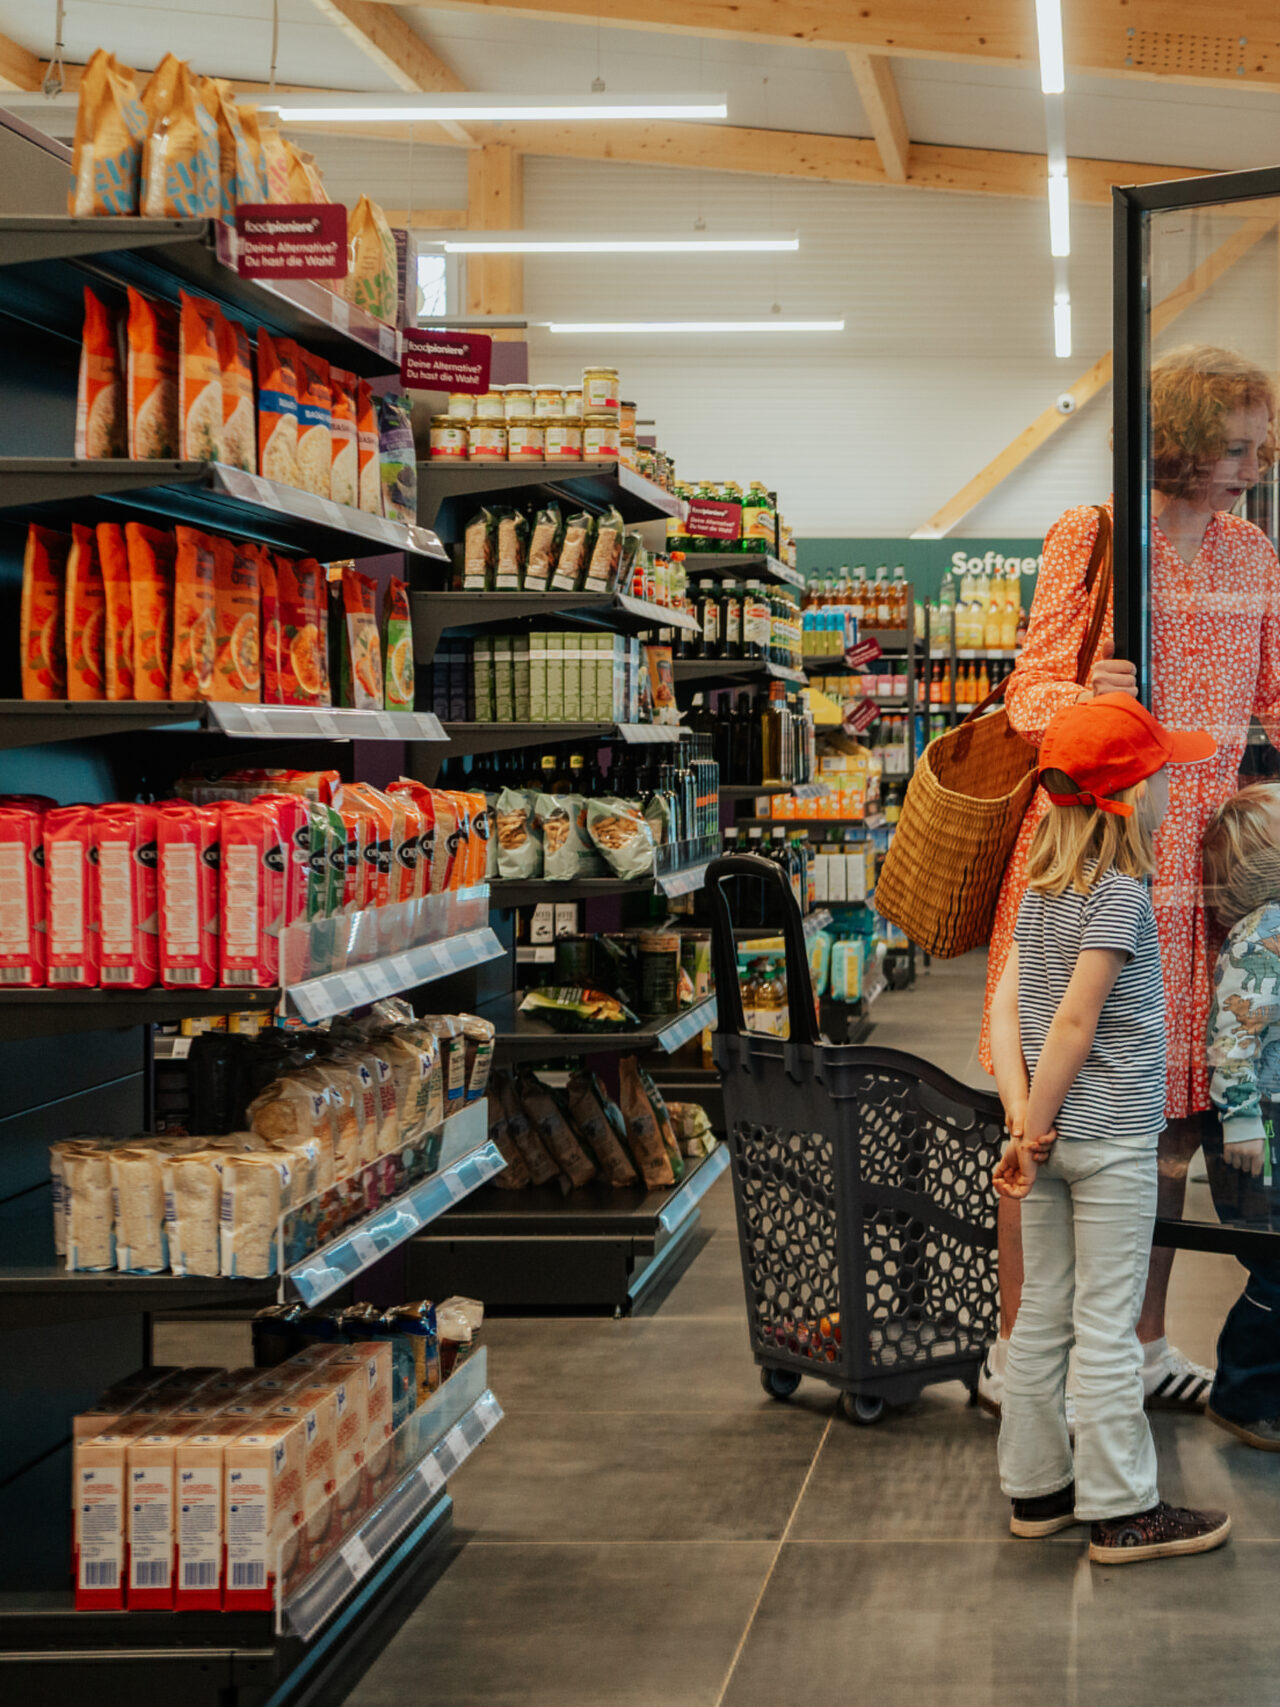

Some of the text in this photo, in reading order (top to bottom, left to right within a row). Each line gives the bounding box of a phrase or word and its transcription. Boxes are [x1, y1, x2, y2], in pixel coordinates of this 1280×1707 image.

[244, 241, 338, 254] Deine Alternative?
[245, 255, 260, 267] Du
[261, 255, 284, 267] hast
[285, 255, 304, 267] die
[407, 358, 482, 374] Deine Alternative?
[406, 369, 419, 379] Du
[420, 371, 439, 381] hast
[439, 372, 454, 383] die
